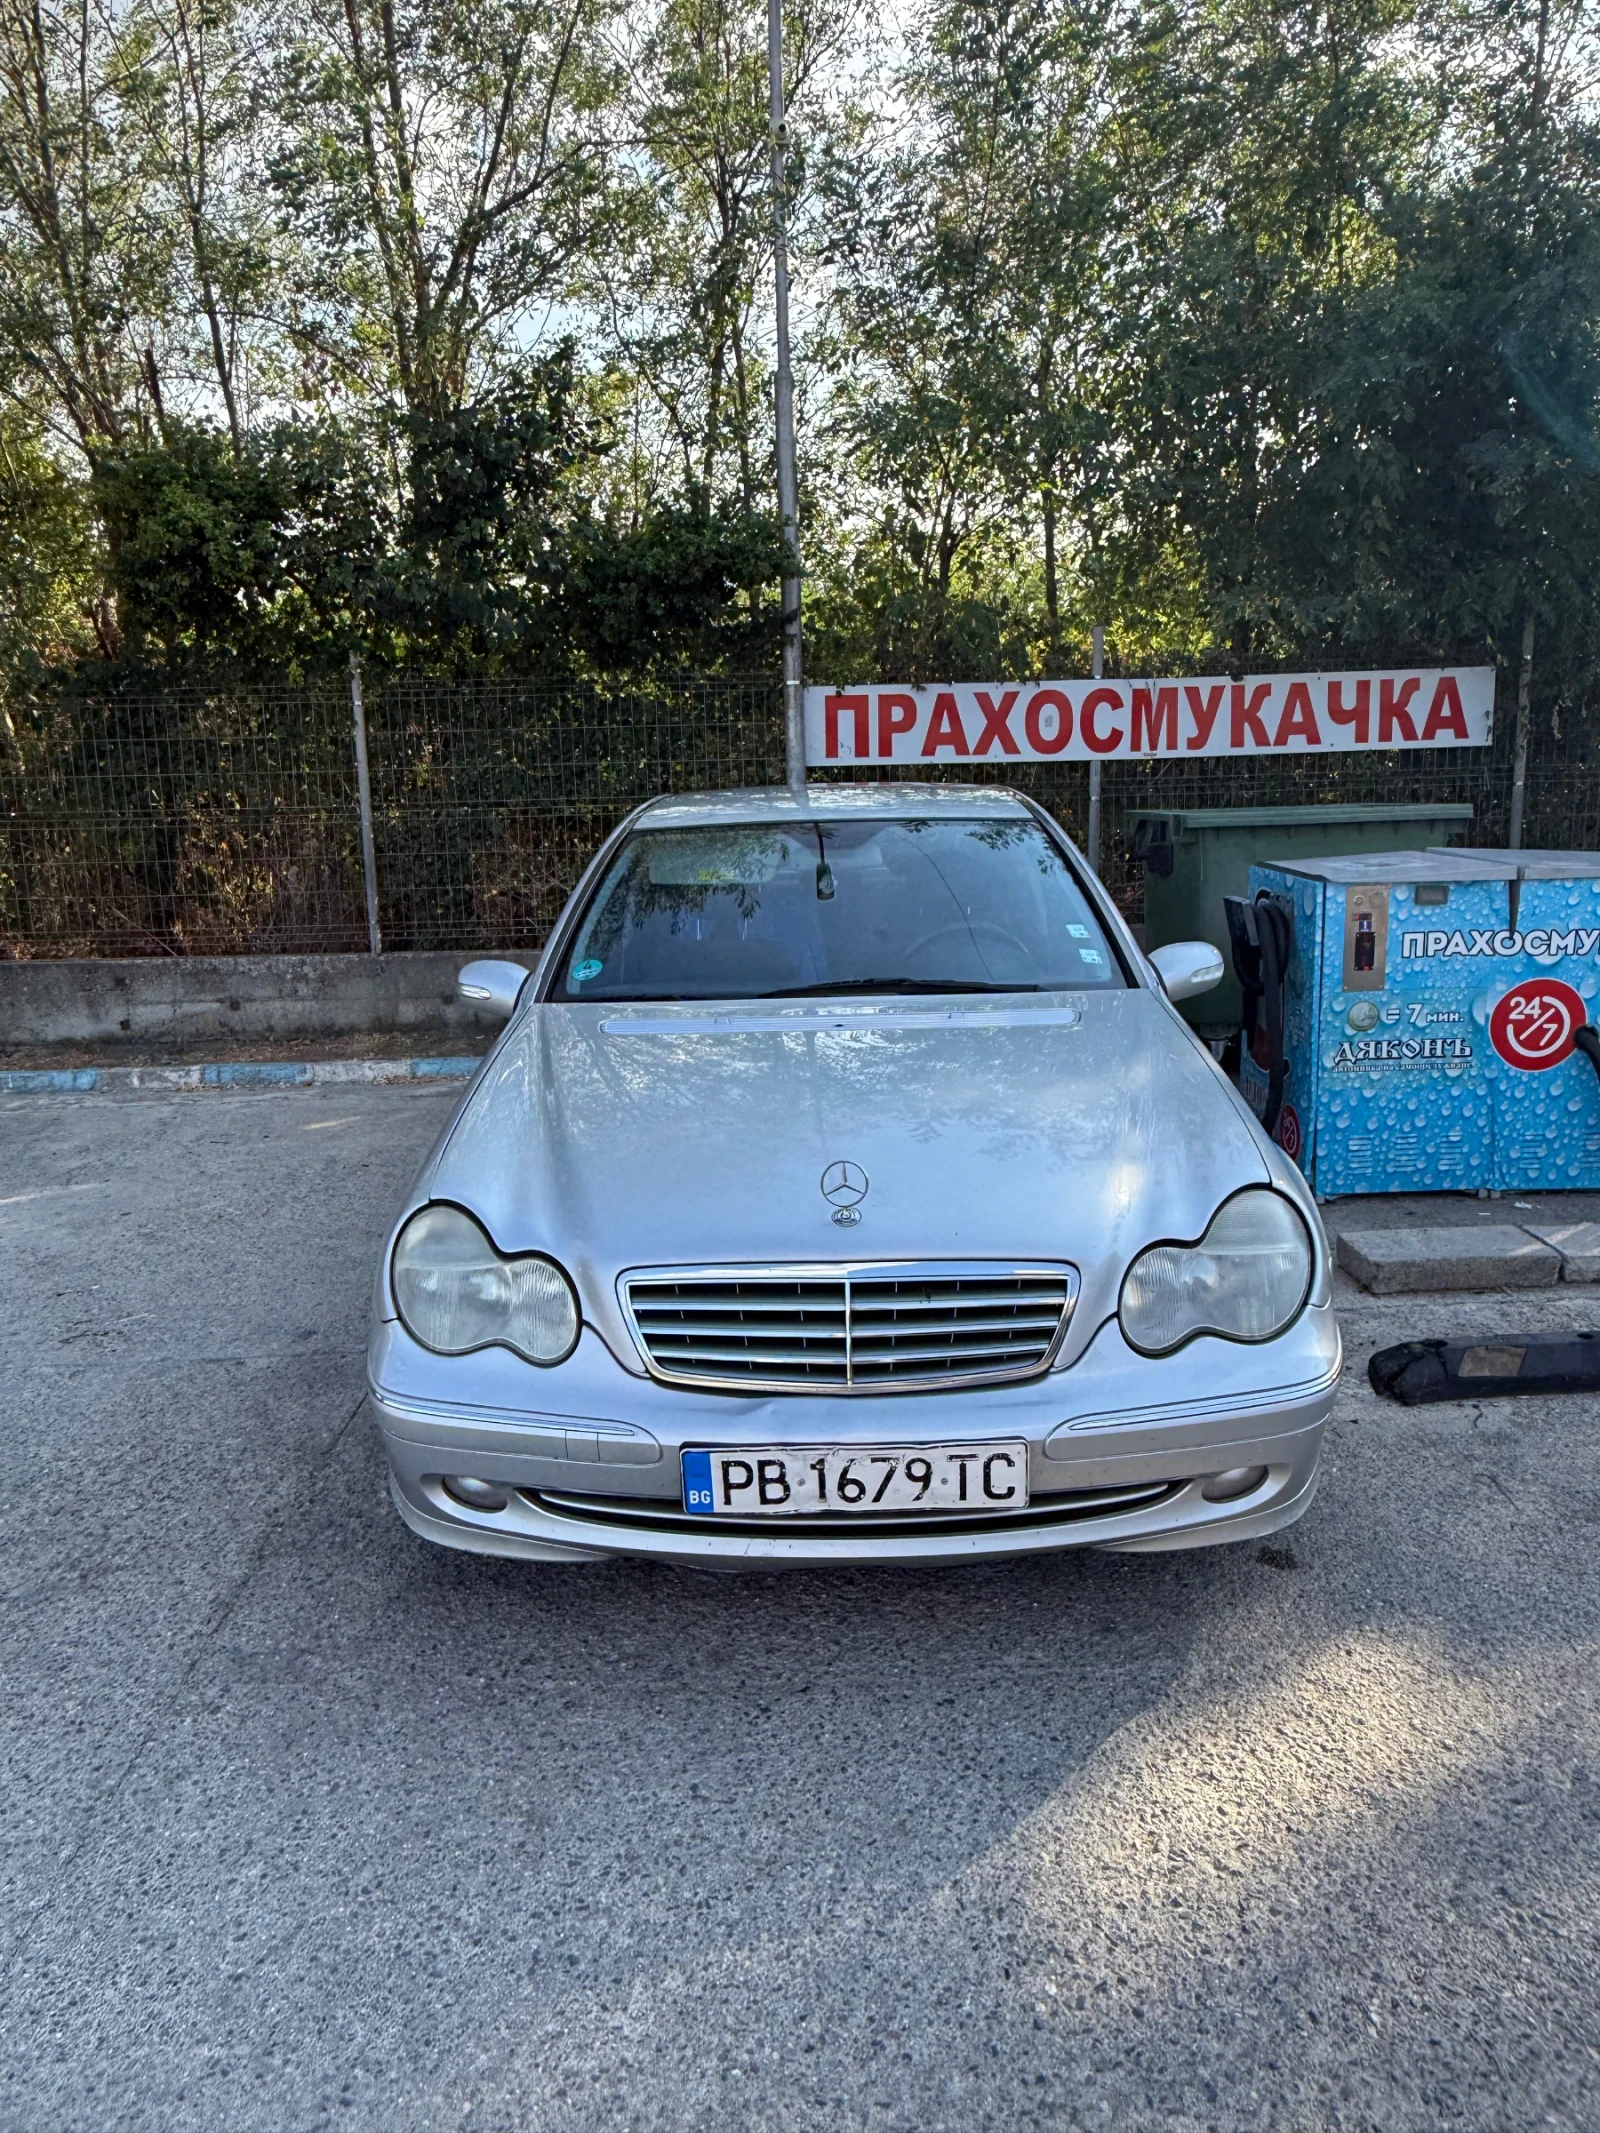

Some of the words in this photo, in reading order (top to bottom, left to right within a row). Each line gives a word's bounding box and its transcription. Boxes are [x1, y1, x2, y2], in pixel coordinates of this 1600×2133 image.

[824, 675, 1470, 758] ПРАХОСМУКАЧКА
[1402, 929, 1600, 958] ПРАХОСМУ
[1407, 1003, 1423, 1024] 7
[1426, 1011, 1464, 1023] мин.
[1508, 996, 1559, 1047] 24/7
[1334, 1038, 1473, 1065] ДЯКОНЪ
[721, 1459, 790, 1506] PB
[809, 1457, 933, 1504] 1679
[947, 1453, 1015, 1501] TC
[689, 1490, 711, 1504] BG
